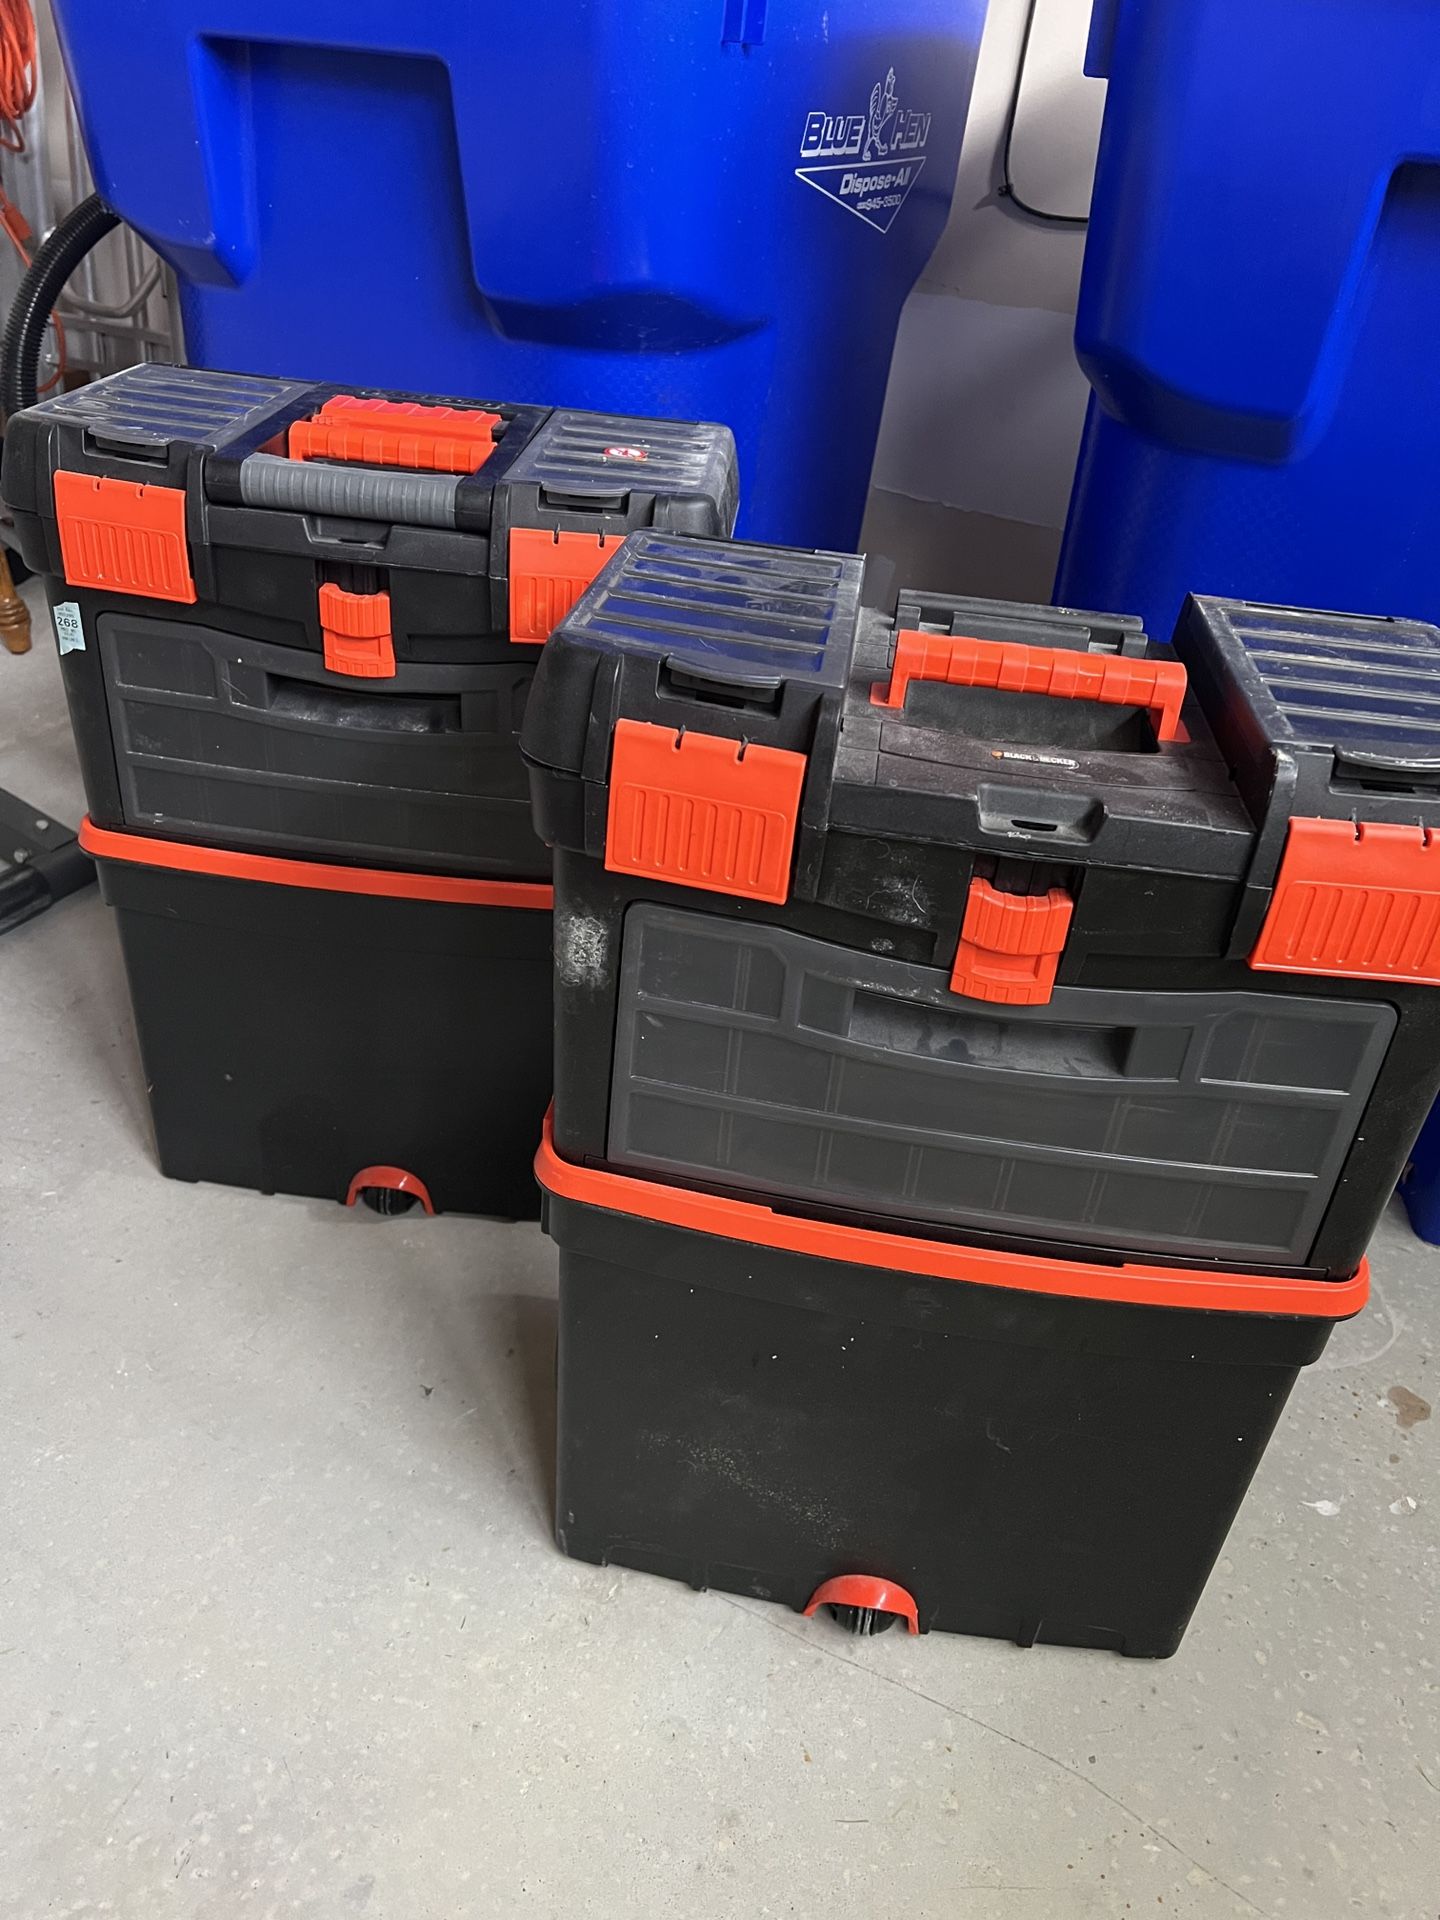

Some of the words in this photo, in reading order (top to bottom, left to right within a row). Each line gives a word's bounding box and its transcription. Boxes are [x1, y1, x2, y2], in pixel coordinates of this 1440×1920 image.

[800, 112, 866, 157] BLUE
[890, 110, 931, 150] HEN
[839, 166, 912, 198] Dispose-All
[57, 616, 79, 629] 268
